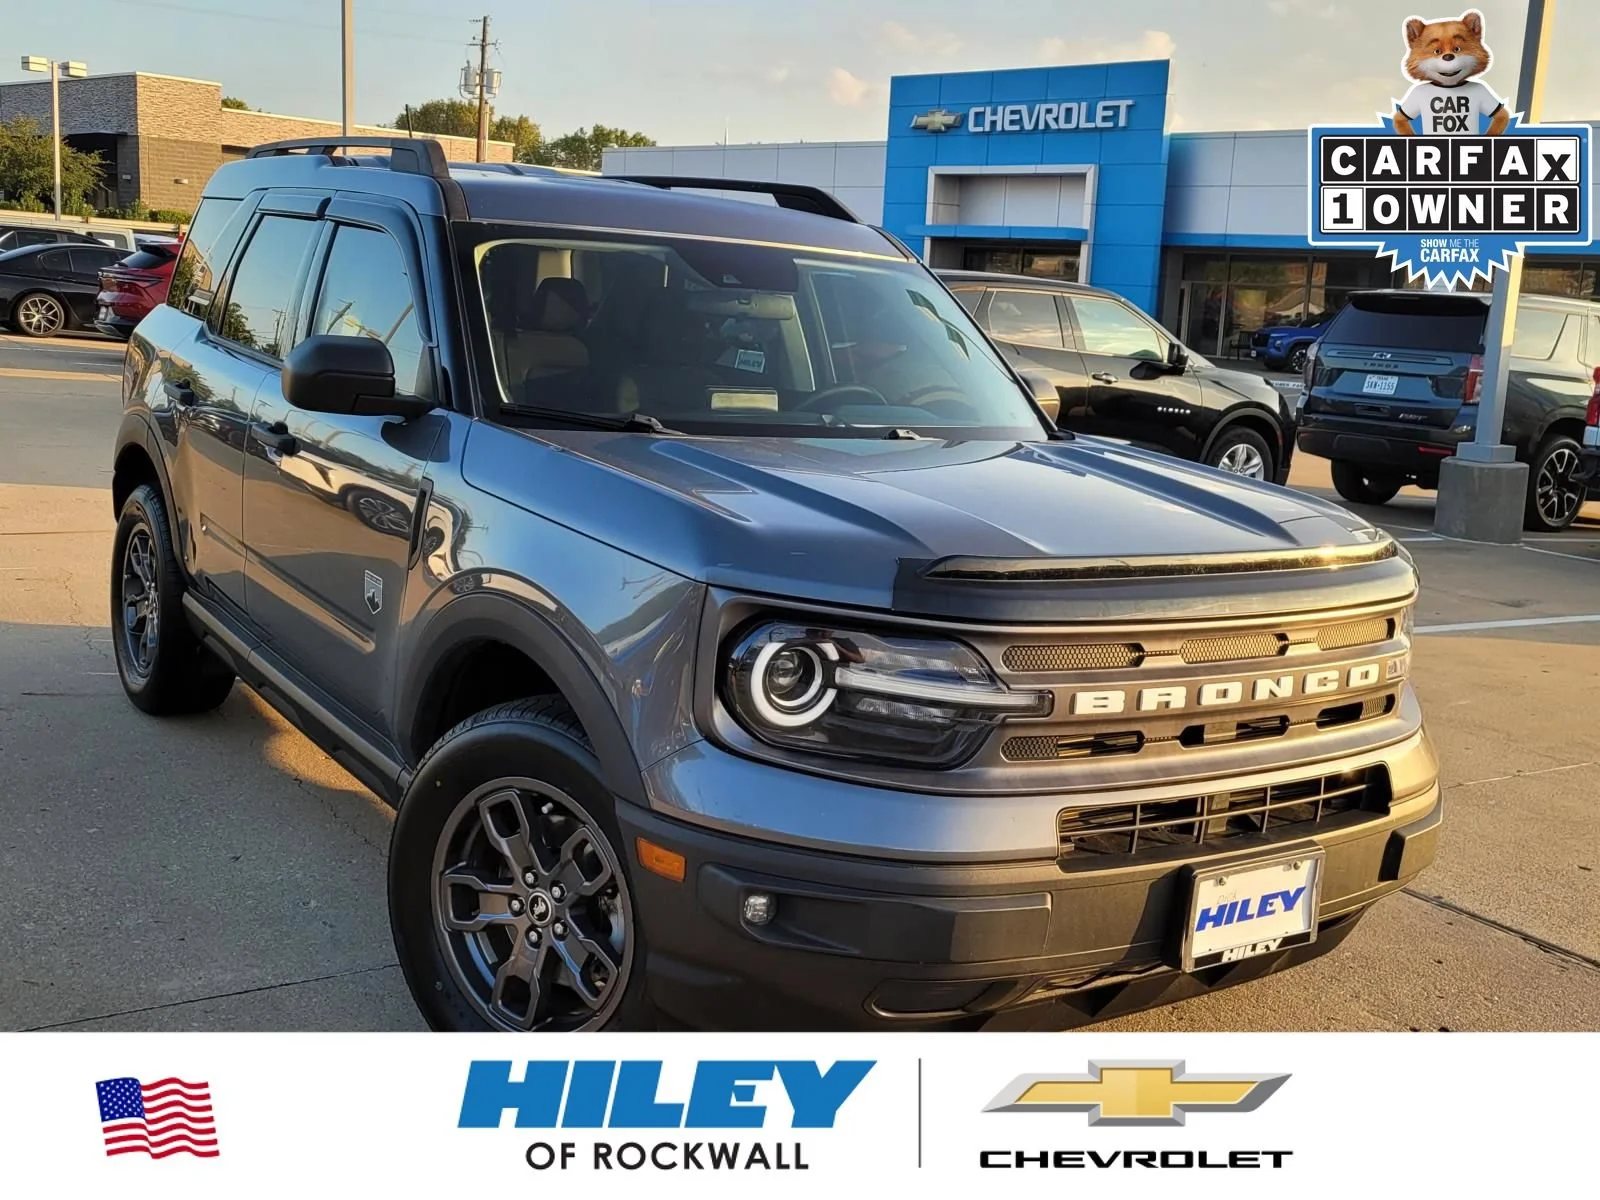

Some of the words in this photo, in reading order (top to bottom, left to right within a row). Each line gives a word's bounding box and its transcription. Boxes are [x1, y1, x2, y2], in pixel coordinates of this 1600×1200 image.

[968, 99, 1136, 133] CHEVROLET
[1070, 663, 1380, 715] BRONCO
[1195, 886, 1307, 932] HILEY
[1221, 937, 1283, 962] HILEY
